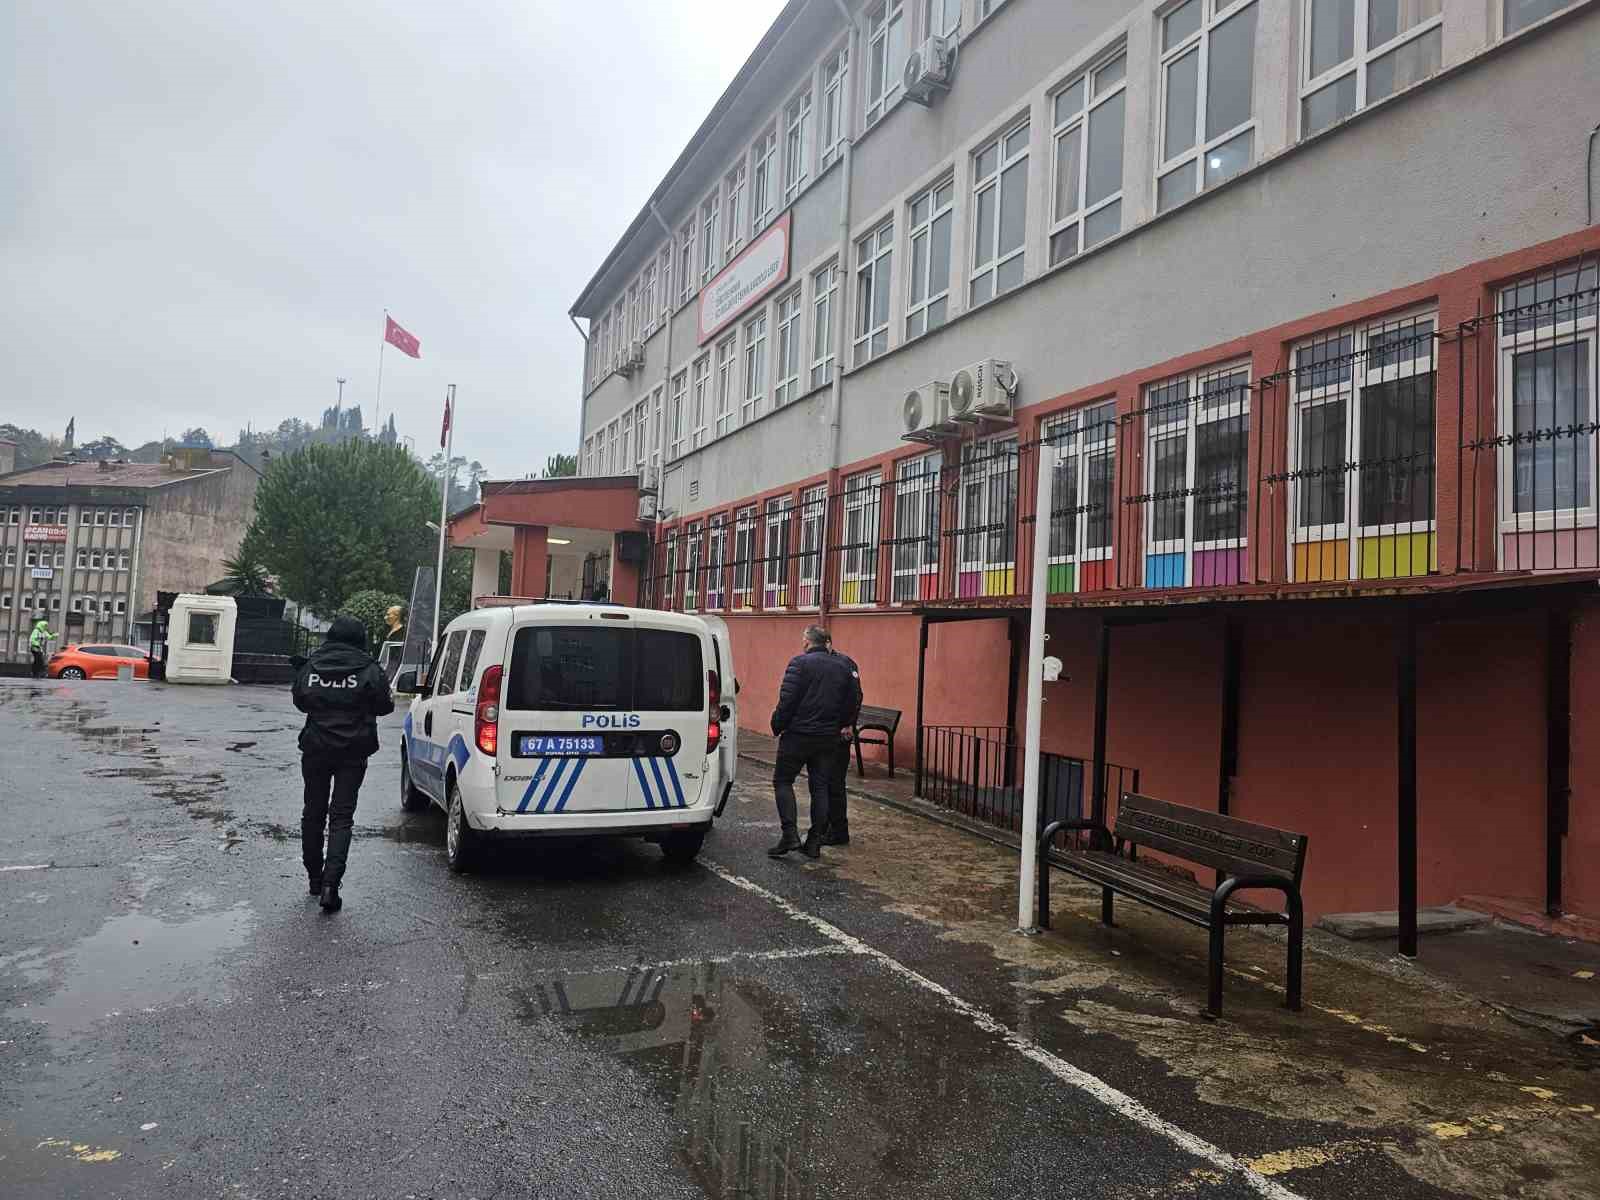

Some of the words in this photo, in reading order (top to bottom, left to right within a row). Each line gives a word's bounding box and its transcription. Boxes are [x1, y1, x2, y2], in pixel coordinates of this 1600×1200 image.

[528, 738, 543, 750] 67
[546, 738, 554, 750] A
[558, 738, 595, 750] 75133
